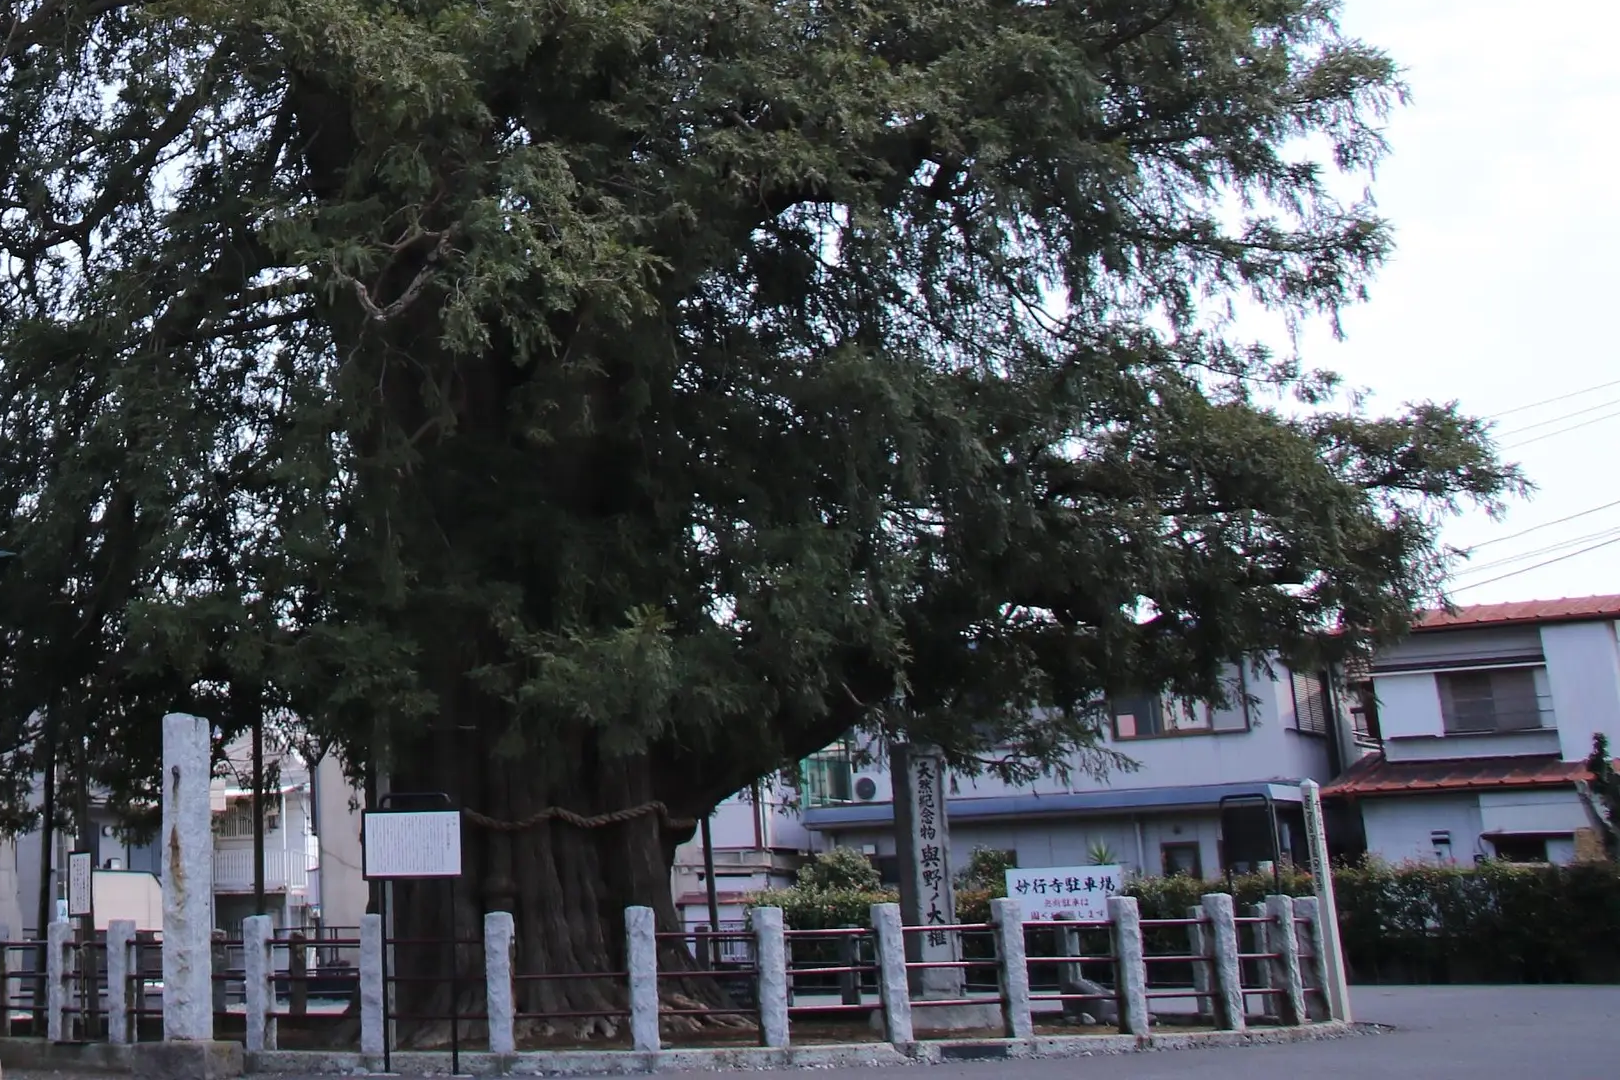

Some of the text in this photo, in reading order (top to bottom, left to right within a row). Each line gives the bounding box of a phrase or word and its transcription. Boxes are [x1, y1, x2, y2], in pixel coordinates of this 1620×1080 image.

[1015, 876, 1115, 895] 妙行寺駐車場
